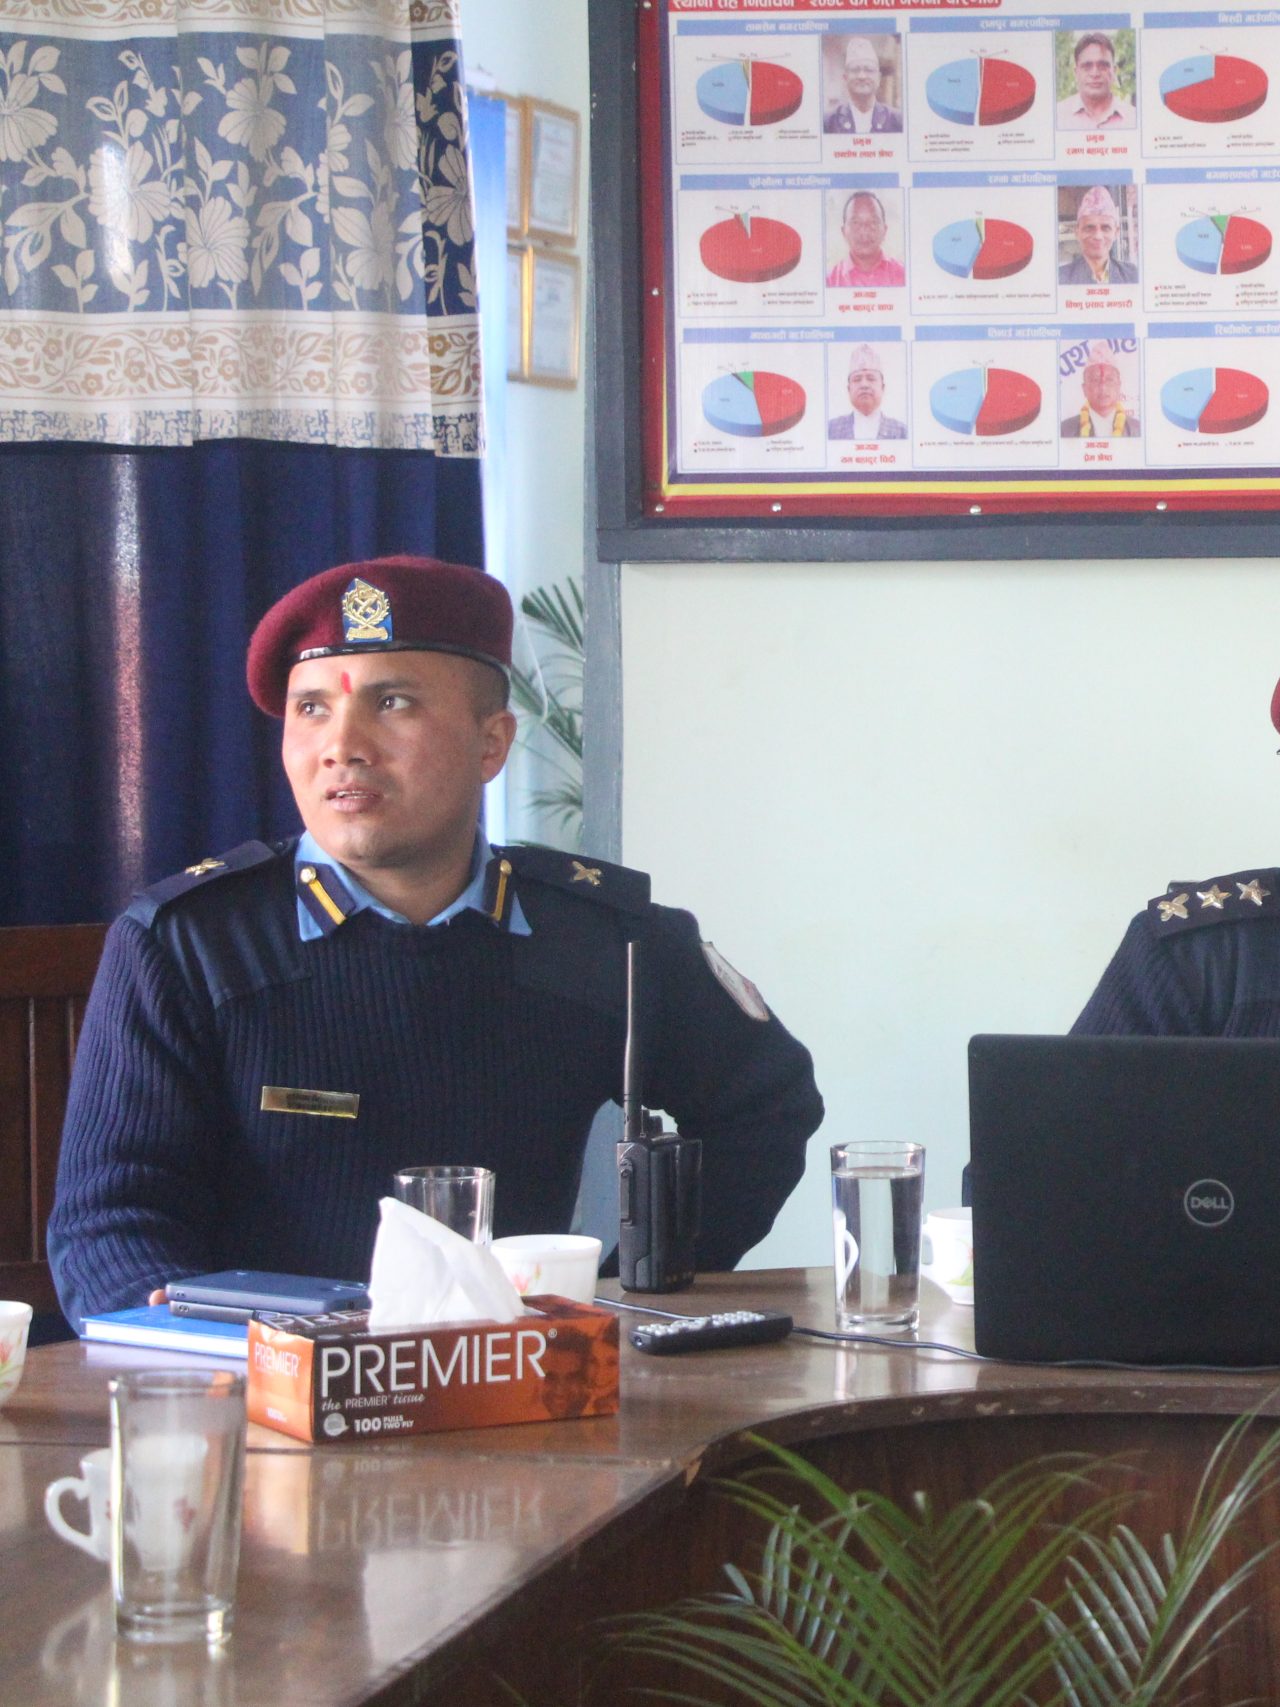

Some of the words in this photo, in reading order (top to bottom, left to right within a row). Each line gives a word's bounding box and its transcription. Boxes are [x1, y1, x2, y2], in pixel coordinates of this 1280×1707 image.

[1190, 1196, 1229, 1209] DELL
[254, 1341, 299, 1377] PREMIER
[322, 1399, 341, 1411] the
[393, 1393, 426, 1405] tissue
[354, 1417, 381, 1433] 100
